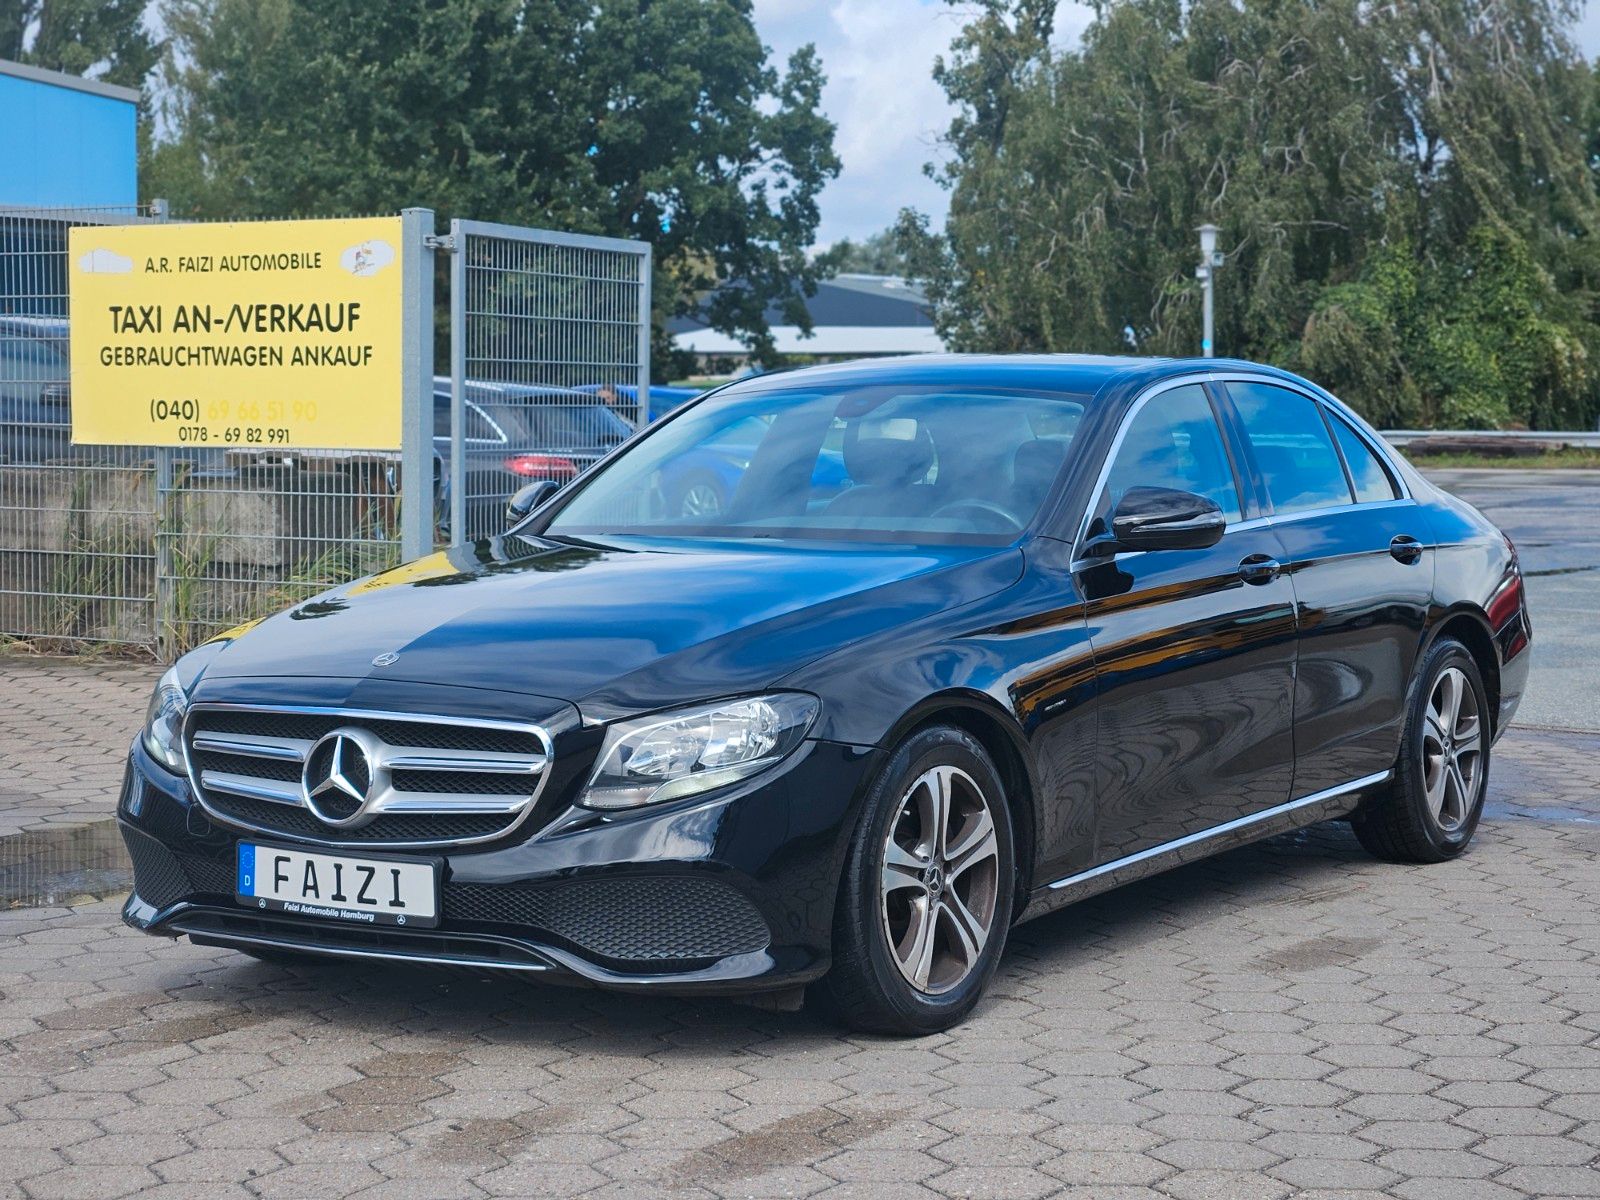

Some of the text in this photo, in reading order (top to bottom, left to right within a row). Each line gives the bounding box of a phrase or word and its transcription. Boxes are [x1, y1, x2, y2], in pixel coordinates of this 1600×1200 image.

[145, 252, 321, 273] A.R. FAIZI AUTOMOBILE
[109, 305, 162, 333] TAXI
[100, 345, 373, 366] GEBRAUCHTWAGEN ANKAUF
[150, 399, 200, 422] (040)
[207, 400, 229, 419] 69
[238, 401, 260, 420] 66
[292, 401, 317, 421] 90
[178, 426, 208, 442] 0178
[224, 427, 241, 442] 69
[246, 428, 262, 442] 82
[267, 428, 290, 443] 991
[244, 875, 251, 886] D
[274, 855, 406, 908] FAIZI
[283, 902, 375, 922] Faizi Automobile Hamburg
